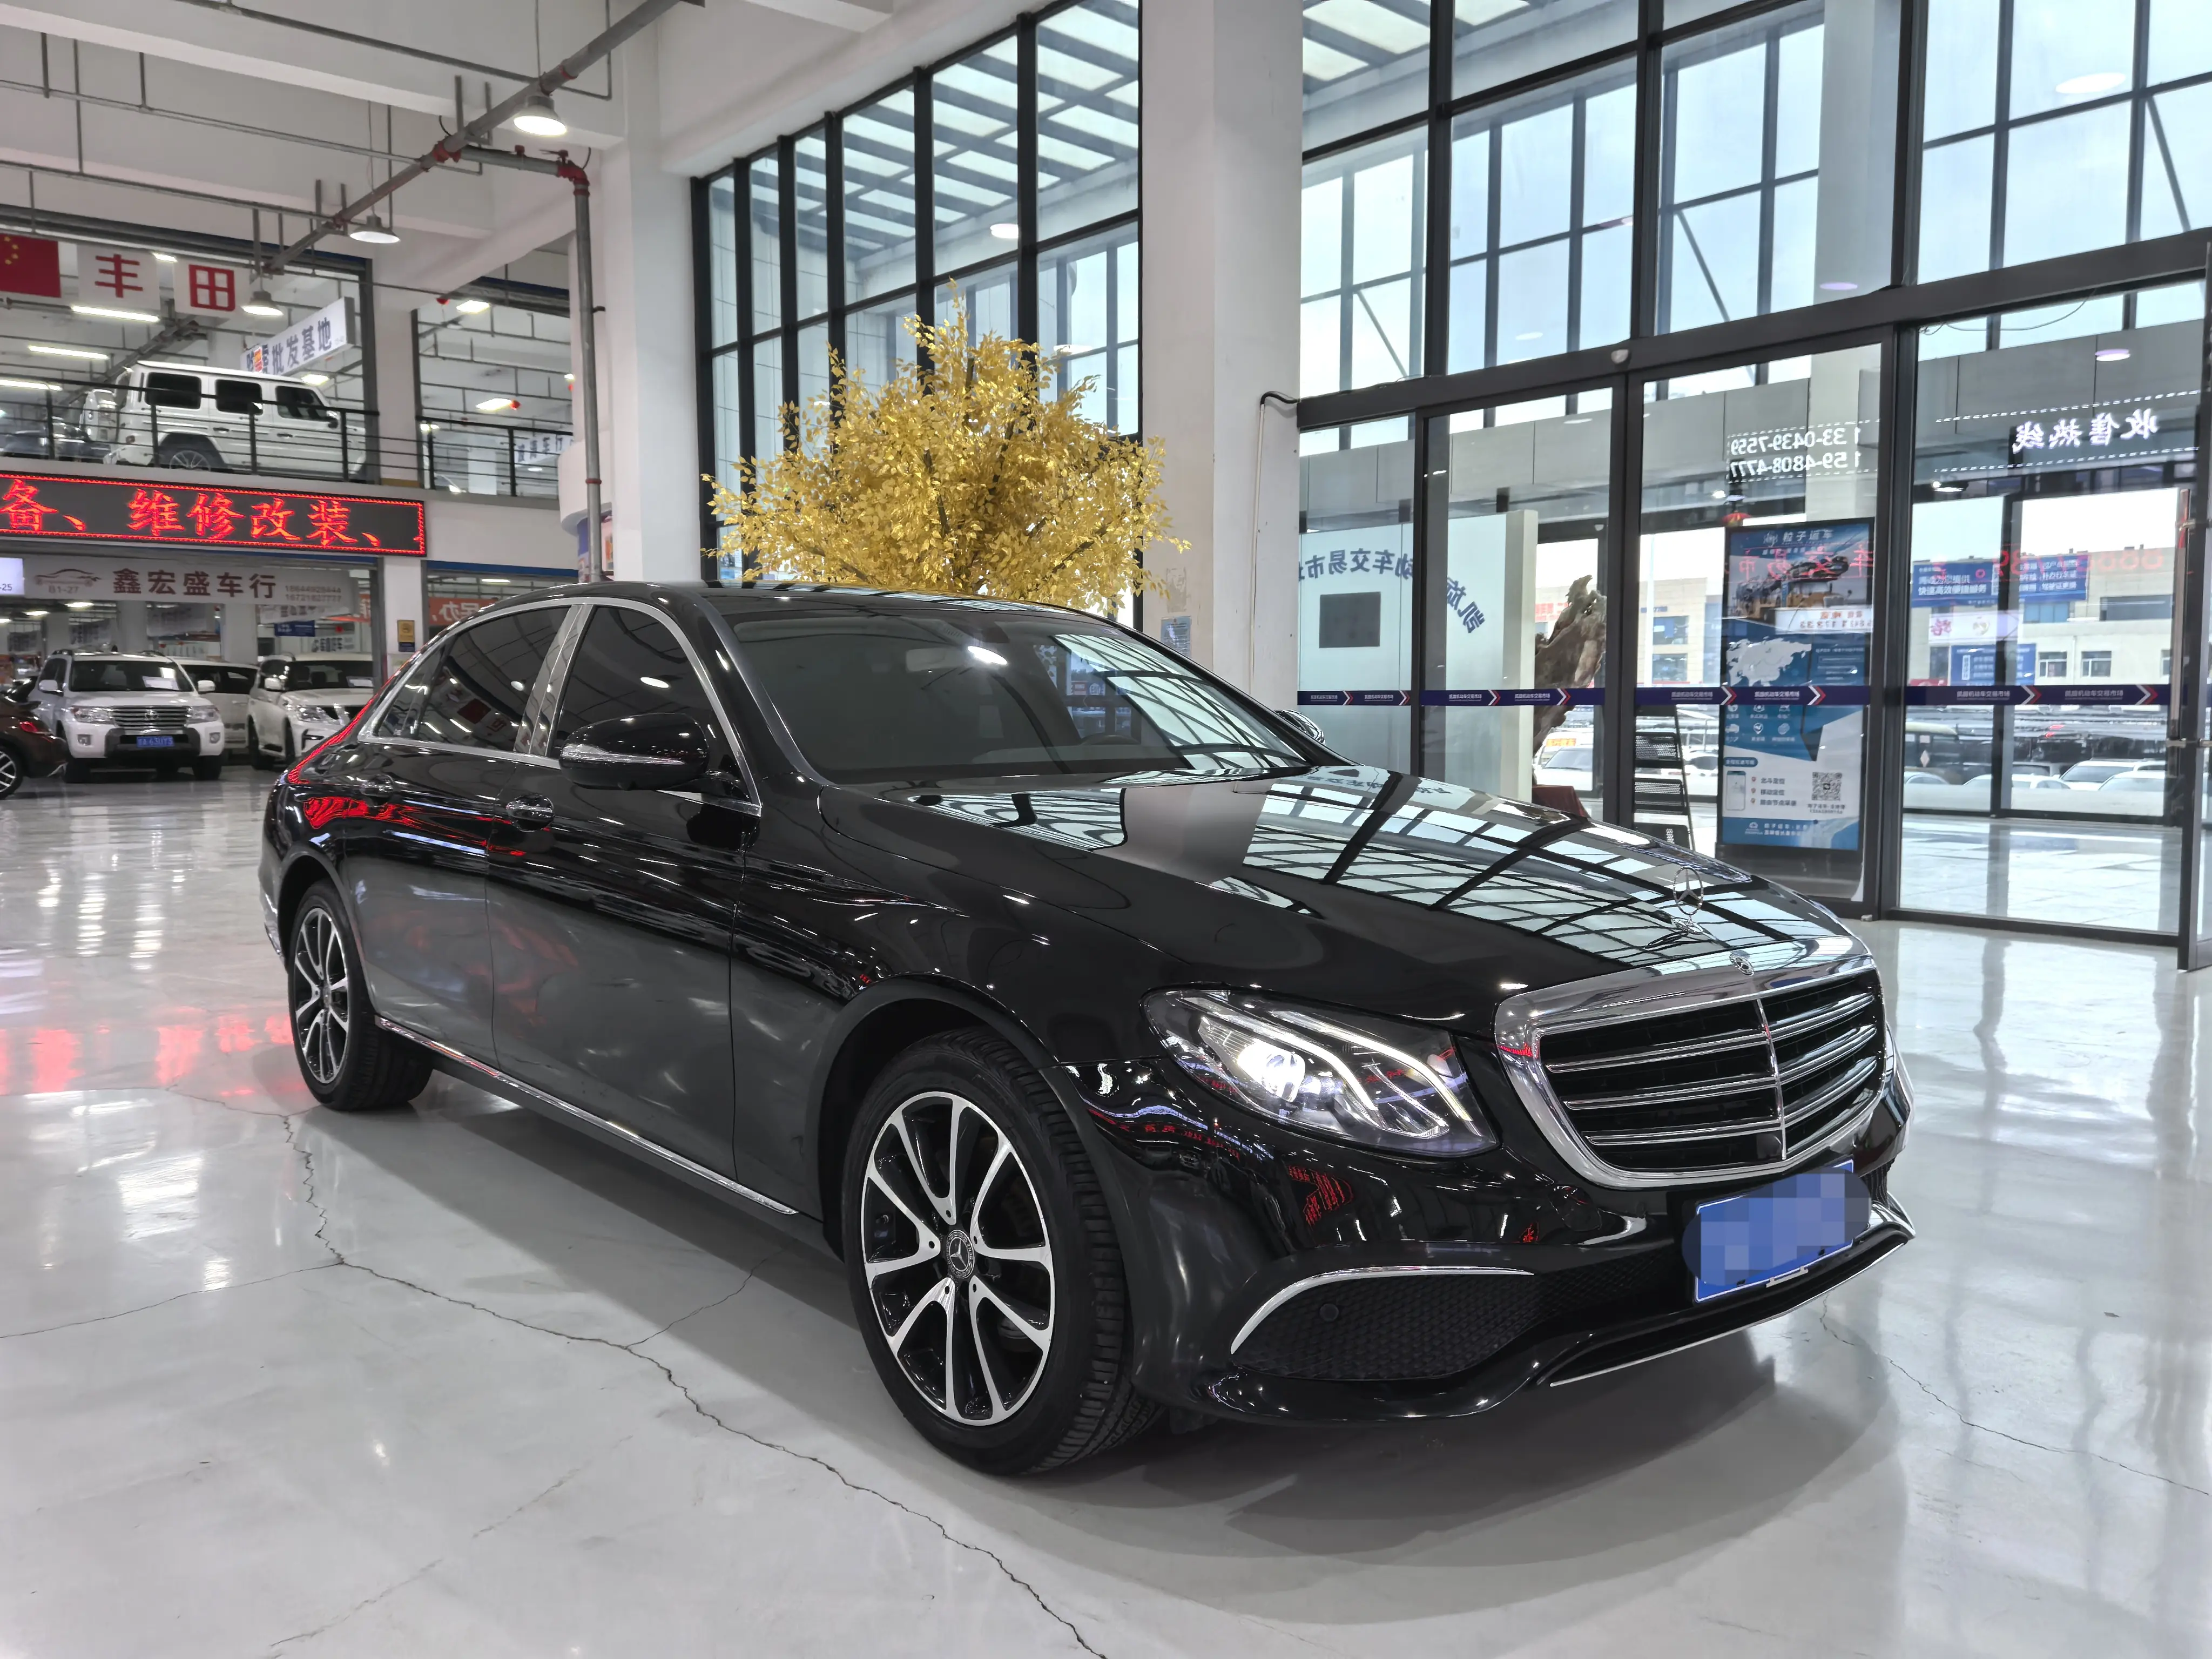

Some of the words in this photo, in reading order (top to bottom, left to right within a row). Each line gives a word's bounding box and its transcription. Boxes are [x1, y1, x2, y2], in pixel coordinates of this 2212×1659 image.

[95, 254, 144, 298] 丰
[188, 264, 235, 312] 田
[113, 568, 276, 599] 鑫宏盛车行
